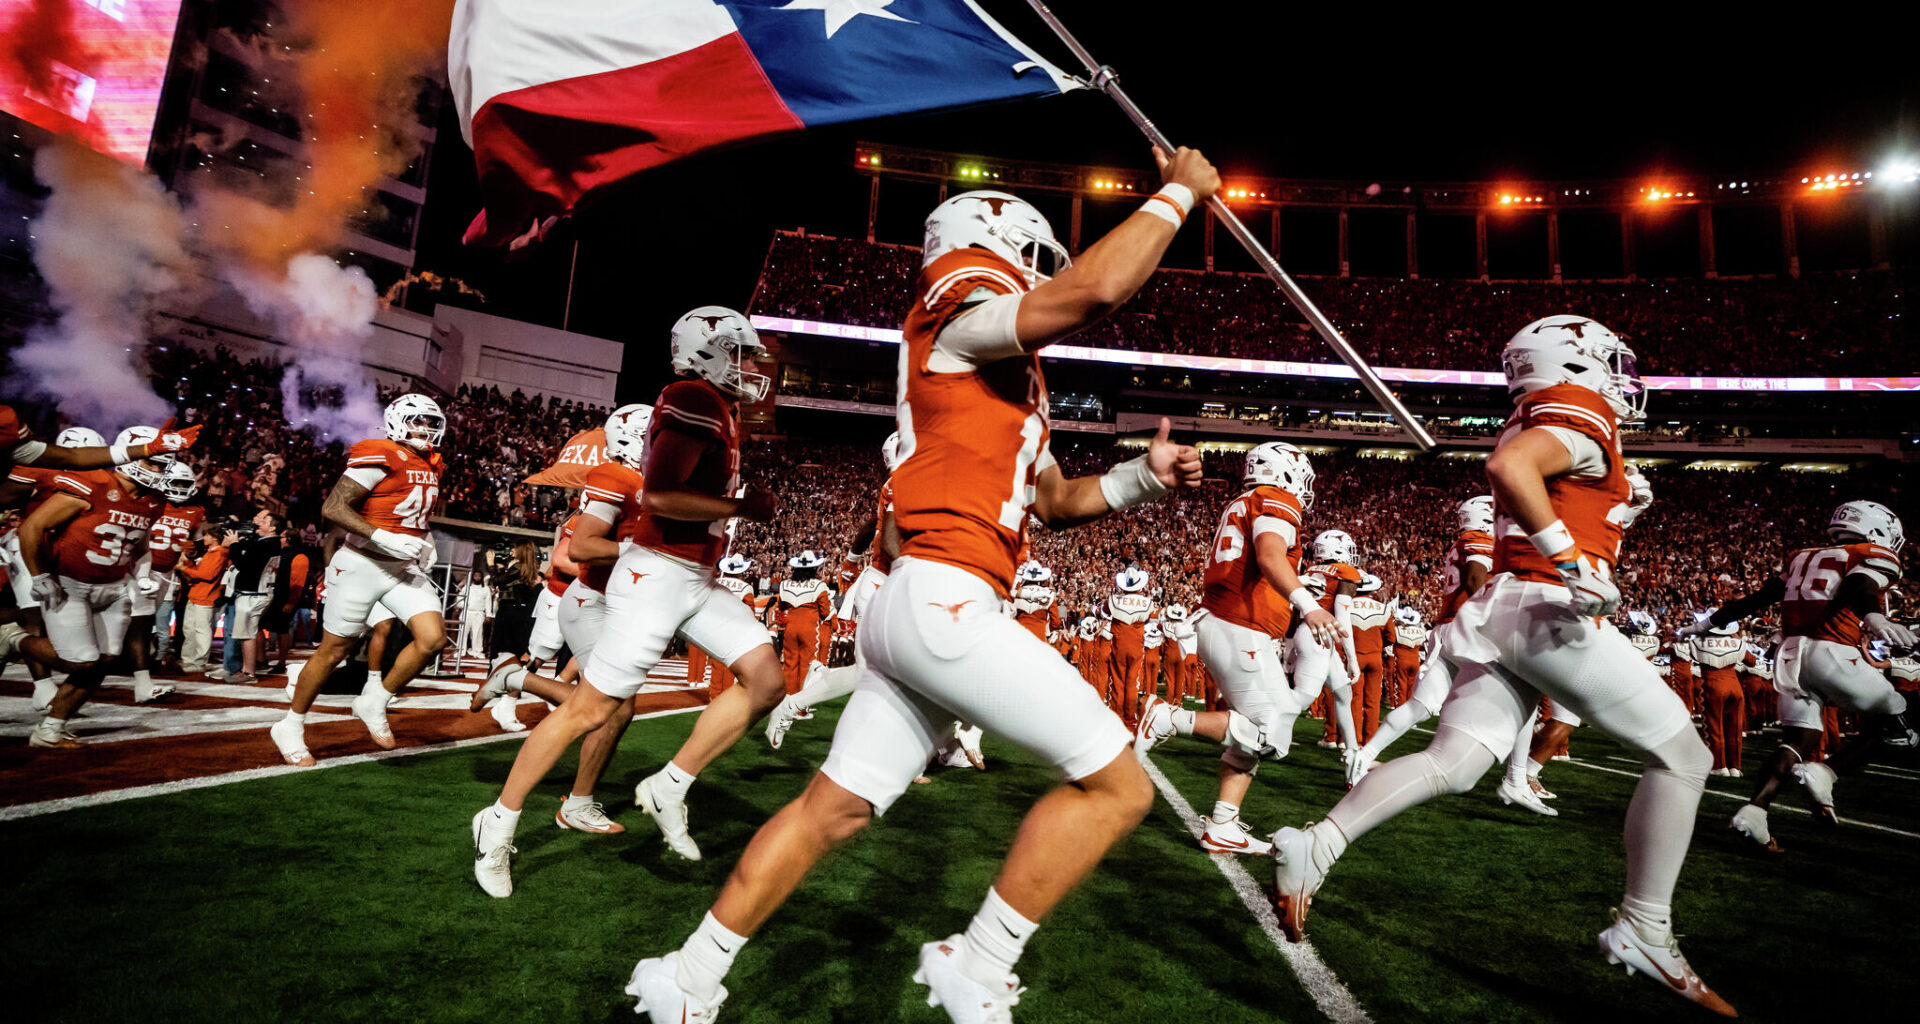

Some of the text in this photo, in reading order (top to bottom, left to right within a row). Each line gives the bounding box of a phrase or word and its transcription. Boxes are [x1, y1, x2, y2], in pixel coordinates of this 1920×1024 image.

[1717, 378, 1740, 389] HERE
[1741, 378, 1766, 389] COME
[1768, 378, 1786, 389] THE
[405, 470, 439, 486] TEXAS
[108, 509, 151, 530] TEXAS
[1784, 549, 1850, 601] 46
[1116, 596, 1147, 608] TEXAS
